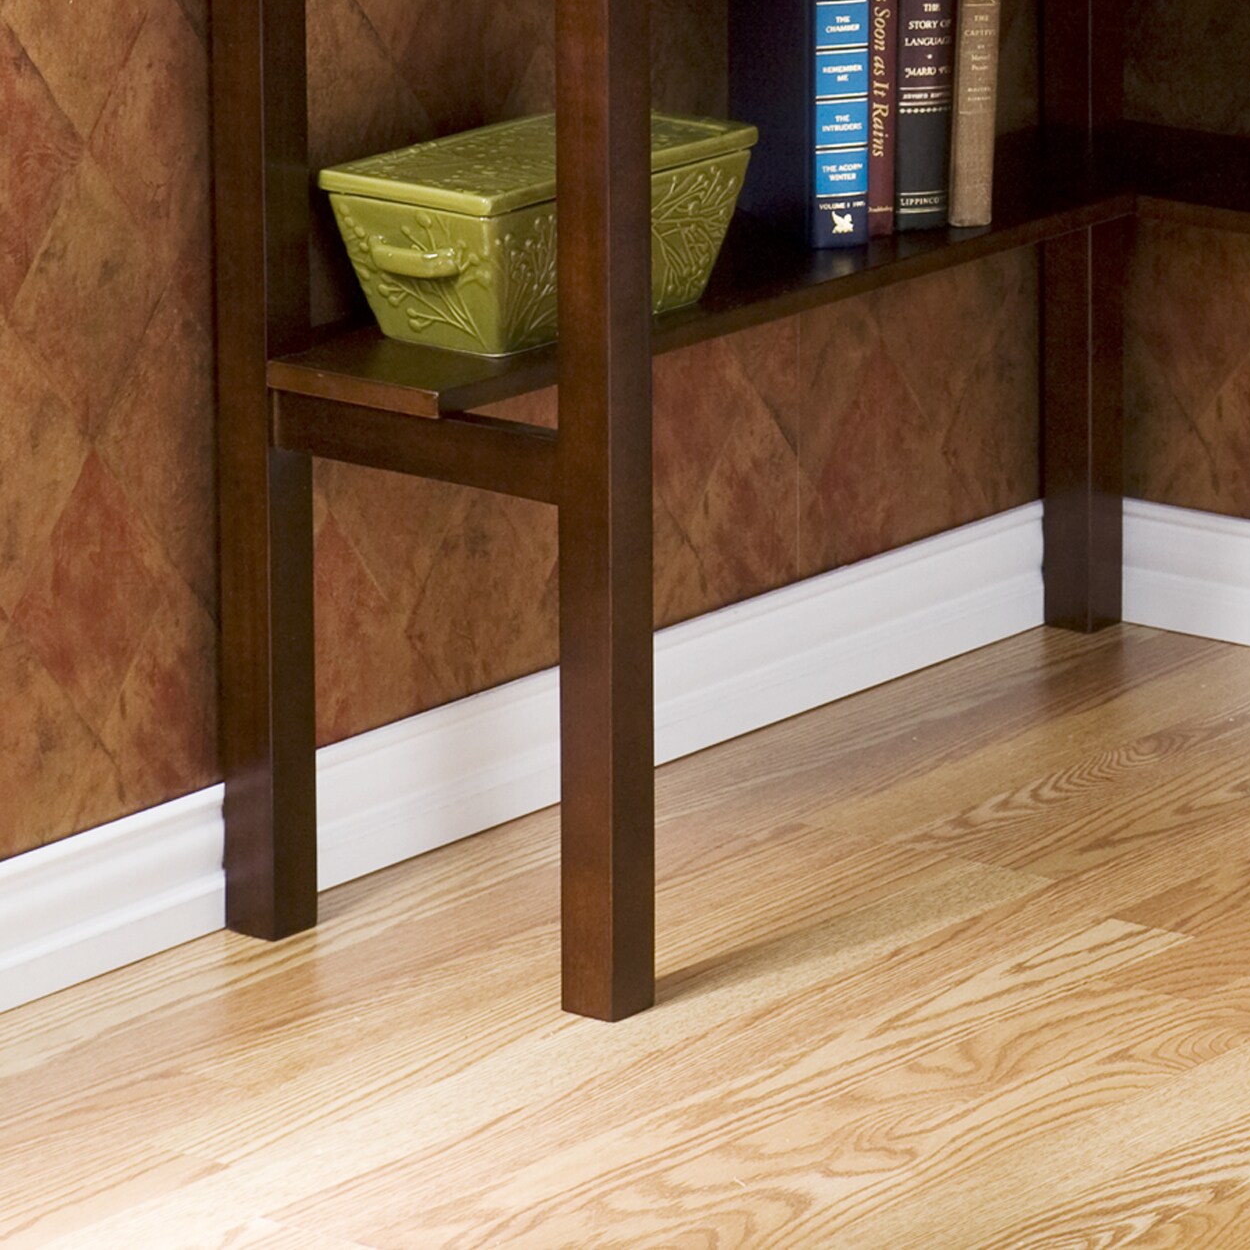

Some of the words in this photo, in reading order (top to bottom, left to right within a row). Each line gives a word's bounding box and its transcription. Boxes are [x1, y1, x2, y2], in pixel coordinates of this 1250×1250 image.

[923, 3, 940, 12] THE
[825, 23, 860, 33] CHAMBER
[873, 7, 891, 51] Soon
[908, 19, 938, 30] STORY
[822, 64, 863, 73] REMEMBER
[873, 55, 885, 76] as
[905, 67, 936, 78] MARIO
[837, 74, 849, 82] ME
[873, 82, 890, 98] It
[835, 114, 850, 123] THE
[822, 123, 863, 132] INTRUDERS
[872, 103, 889, 157] Rains
[822, 165, 838, 173] THE
[838, 163, 863, 172] ACORN
[829, 173, 856, 181] WINTER
[819, 202, 846, 210] VOLUME
[900, 196, 943, 206] LIPPINCO
